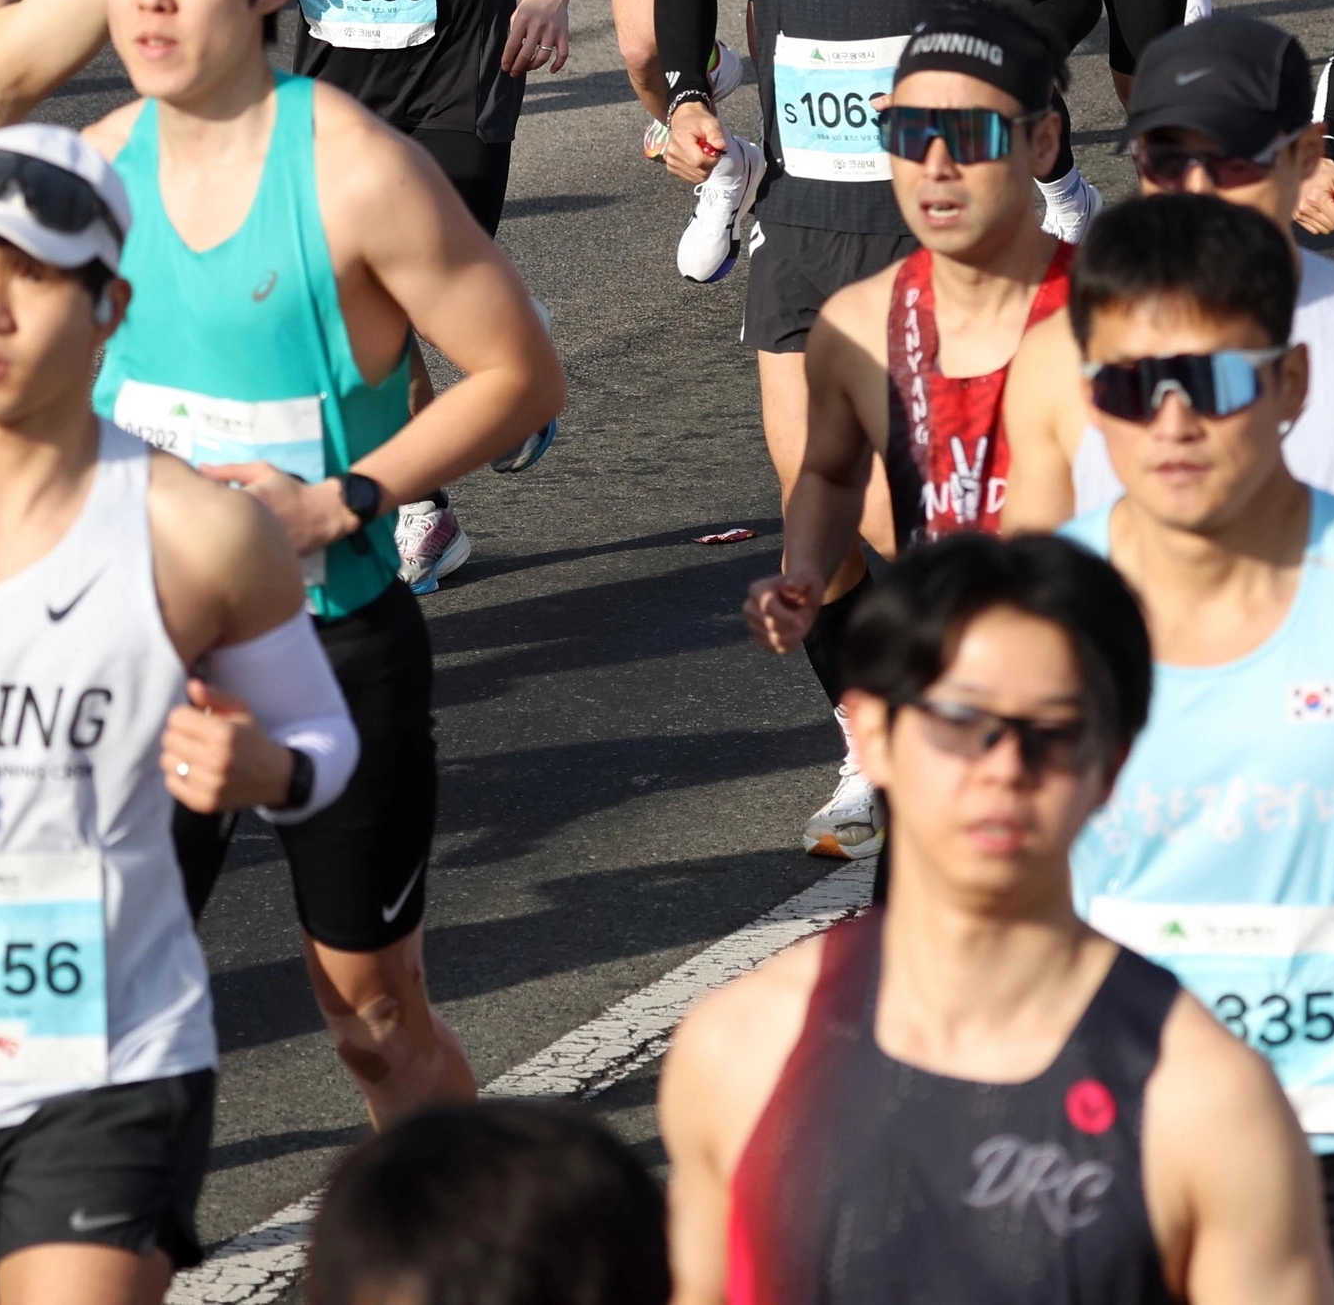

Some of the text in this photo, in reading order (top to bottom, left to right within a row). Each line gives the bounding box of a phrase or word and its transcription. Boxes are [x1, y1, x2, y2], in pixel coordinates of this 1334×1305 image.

[832, 51, 876, 60] 대구광역시
[784, 103, 798, 124] S
[848, 159, 876, 169] 크레텍
[905, 287, 930, 445] DANYANG
[961, 1132, 1116, 1237] DRC
